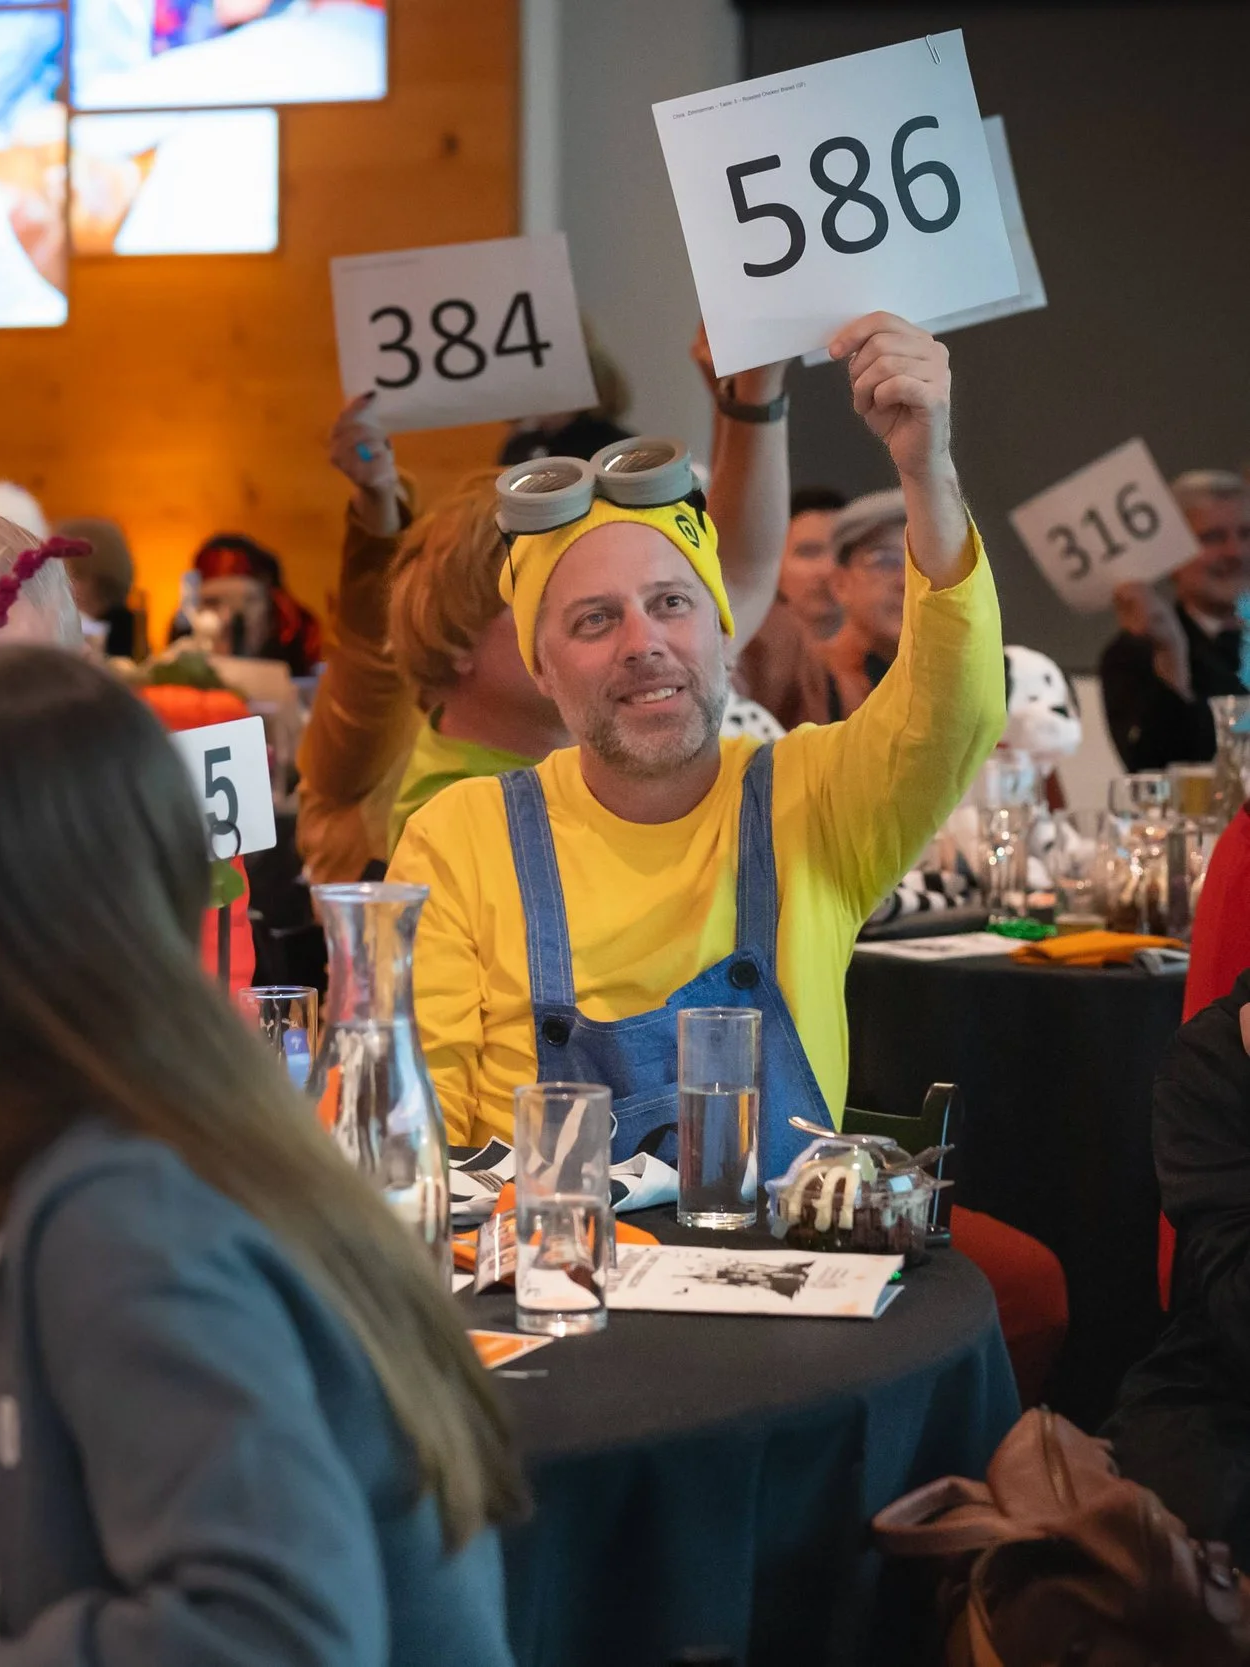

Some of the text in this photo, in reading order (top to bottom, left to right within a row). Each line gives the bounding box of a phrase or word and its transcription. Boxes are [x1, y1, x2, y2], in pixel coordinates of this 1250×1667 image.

[725, 115, 961, 278] 586
[369, 291, 552, 390] 384
[1047, 480, 1161, 580] 316
[204, 745, 239, 836] 5
